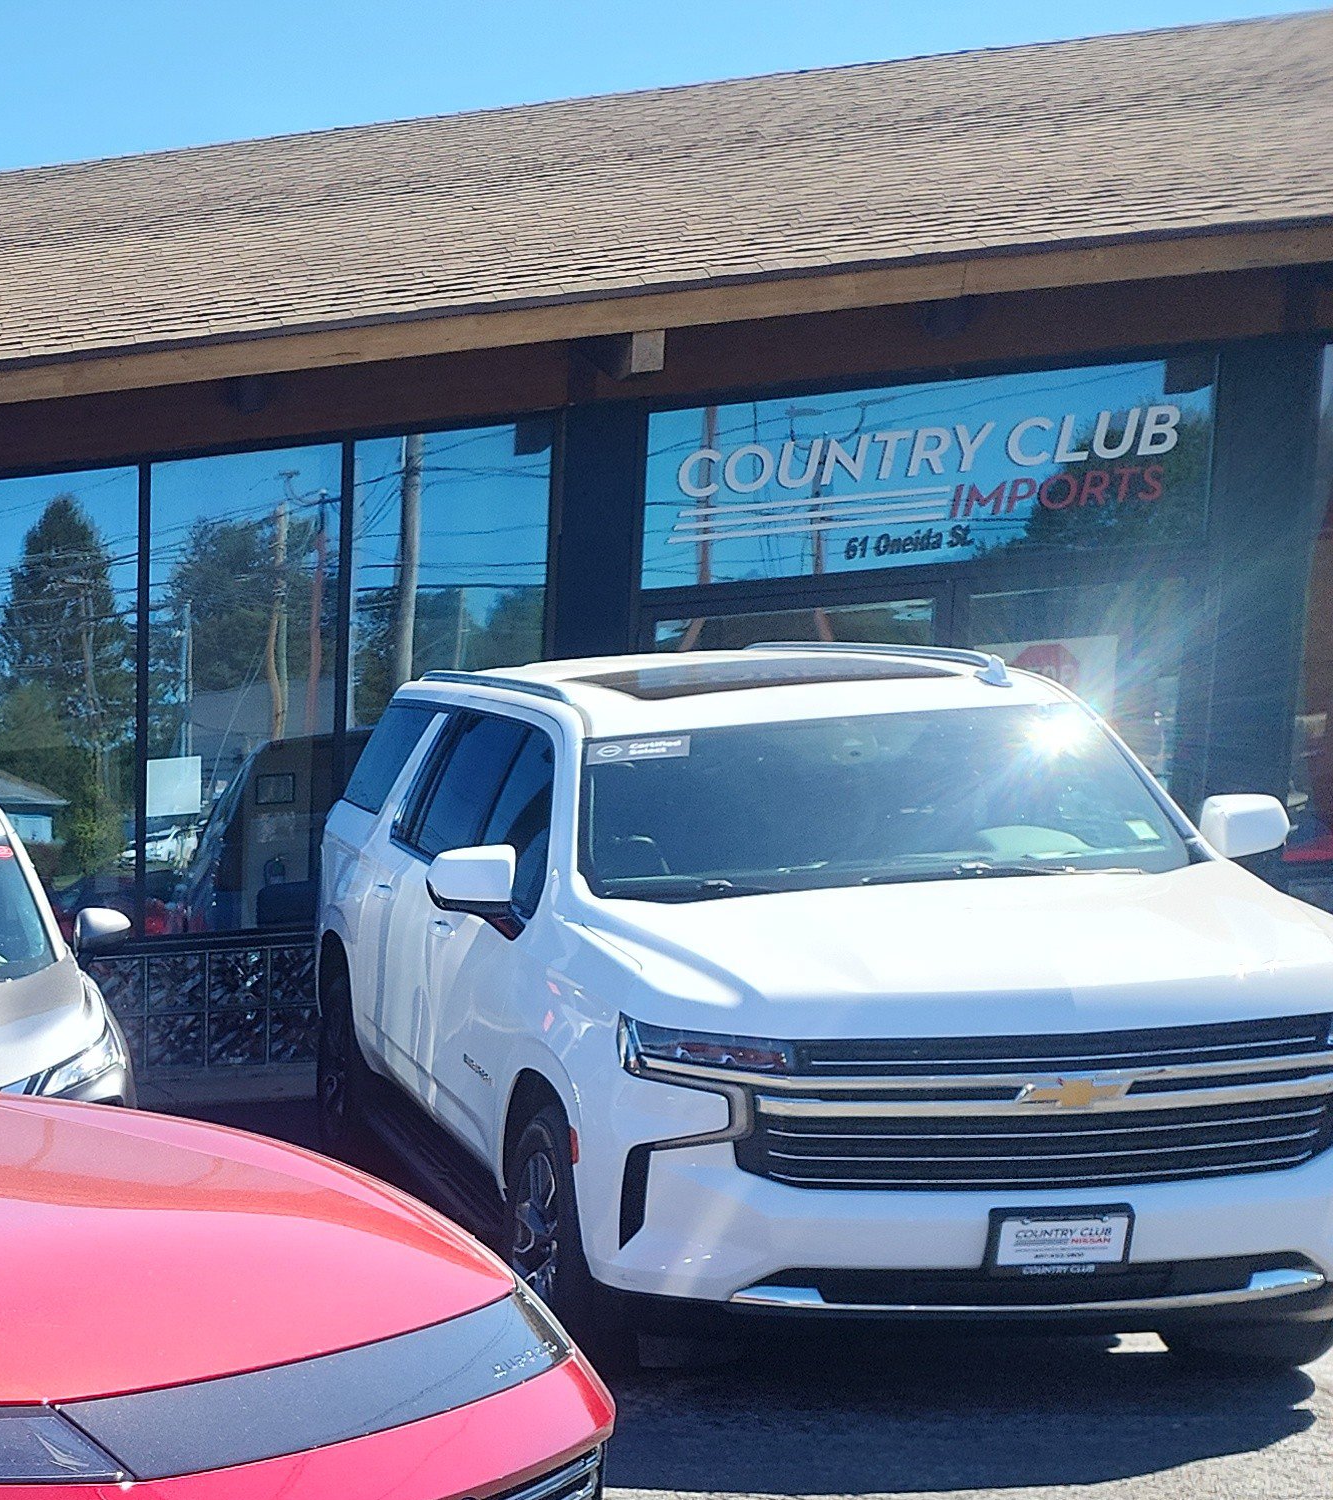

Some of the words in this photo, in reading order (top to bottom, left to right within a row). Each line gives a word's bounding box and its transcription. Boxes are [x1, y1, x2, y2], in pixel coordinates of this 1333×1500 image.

[678, 421, 996, 499] COUNTRY
[1006, 404, 1181, 467] CLUB
[949, 466, 1165, 519] IMPORTS
[844, 535, 869, 560] 61
[874, 528, 943, 557] Oneida
[1015, 1228, 1076, 1239] COUNTRY
[1080, 1227, 1112, 1236] CLUB
